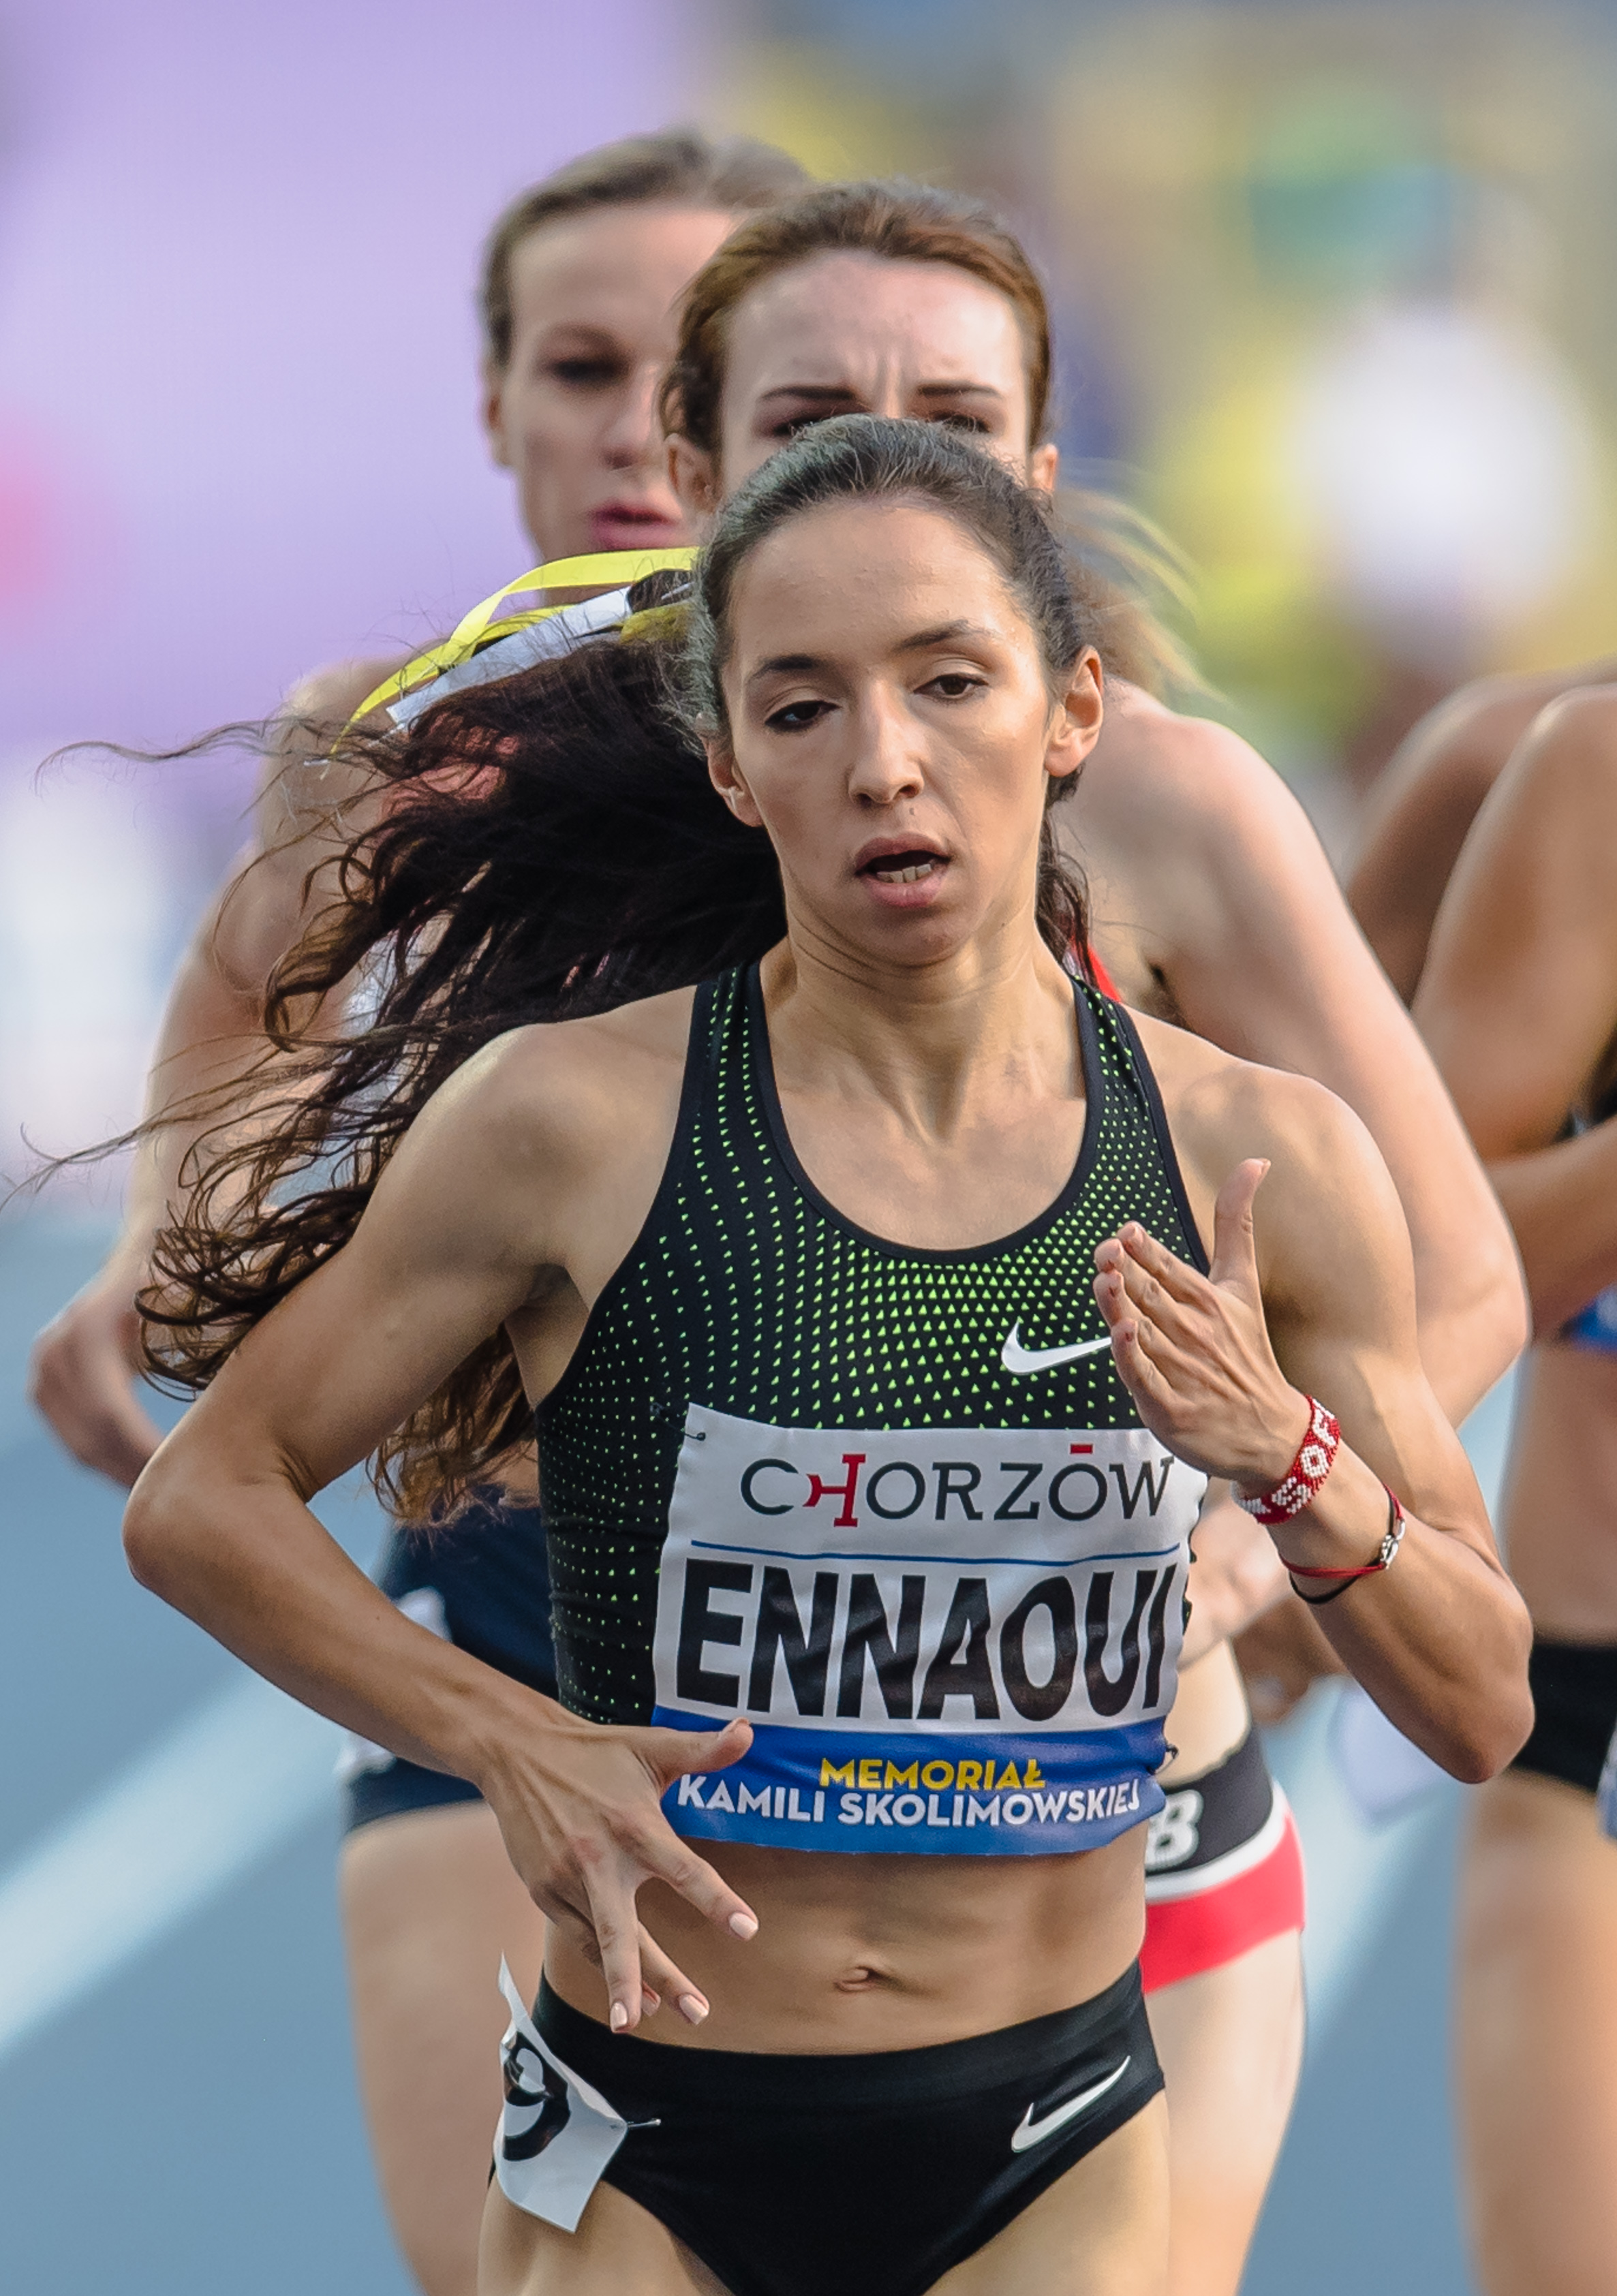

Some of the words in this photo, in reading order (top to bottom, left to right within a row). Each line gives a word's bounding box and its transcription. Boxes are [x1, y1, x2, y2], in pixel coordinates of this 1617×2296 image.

[677, 1557, 1177, 1722] ENNAOUI
[677, 1773, 825, 1822] KAMILI
[837, 1778, 1140, 1827] SKOLIMOWSKIEJ
[819, 1757, 1045, 1791] MEMORIAŁ
